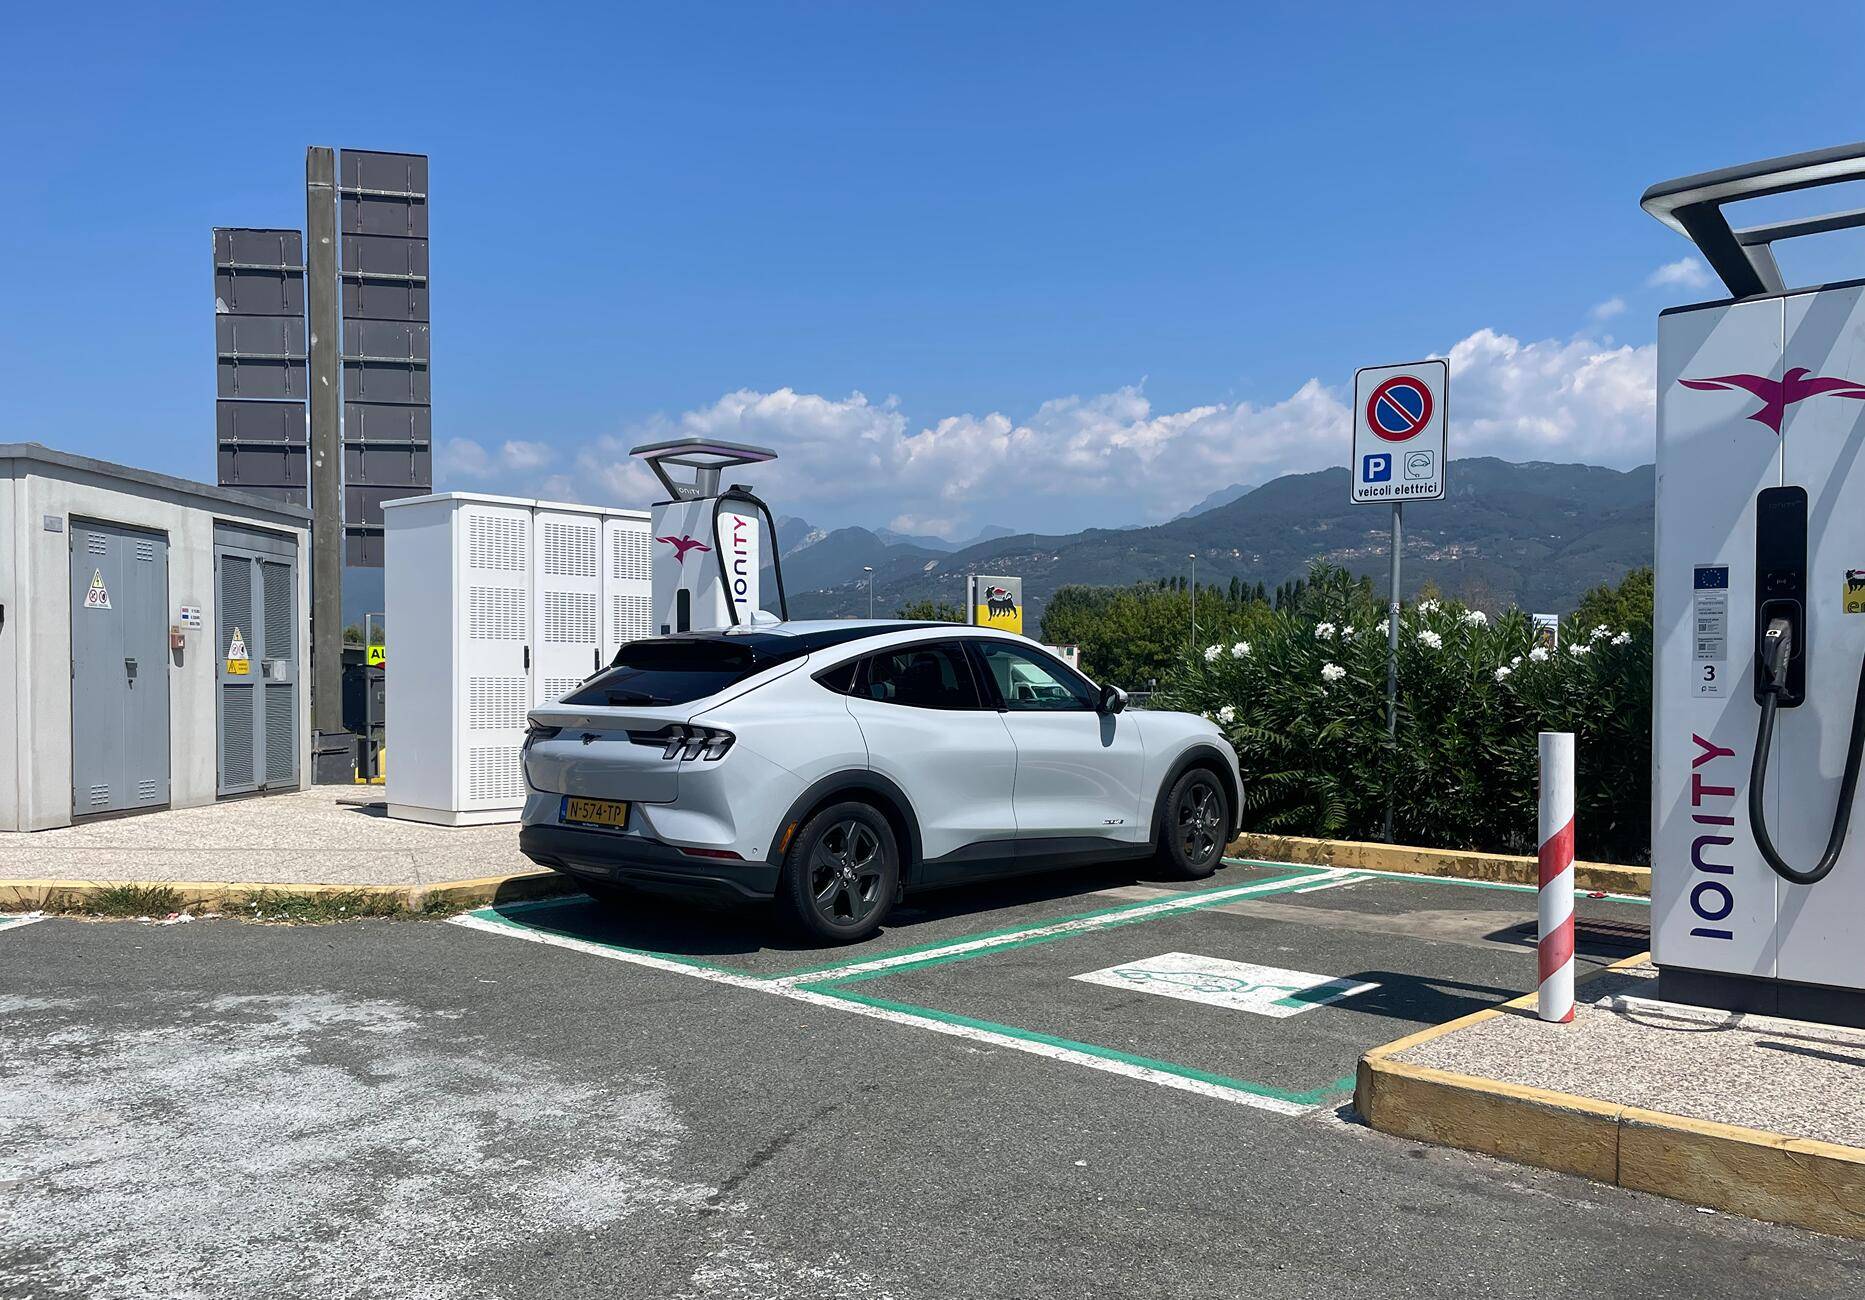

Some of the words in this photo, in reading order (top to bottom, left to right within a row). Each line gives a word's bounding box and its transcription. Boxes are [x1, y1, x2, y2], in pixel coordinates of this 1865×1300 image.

[1368, 457, 1386, 480] P
[1358, 485, 1391, 497] veicoli
[1394, 482, 1438, 495] elettrici
[733, 515, 748, 604] IONITY
[1703, 665, 1716, 681] 3
[570, 801, 621, 822] N-574-TP
[1689, 732, 1736, 941] IONITY
